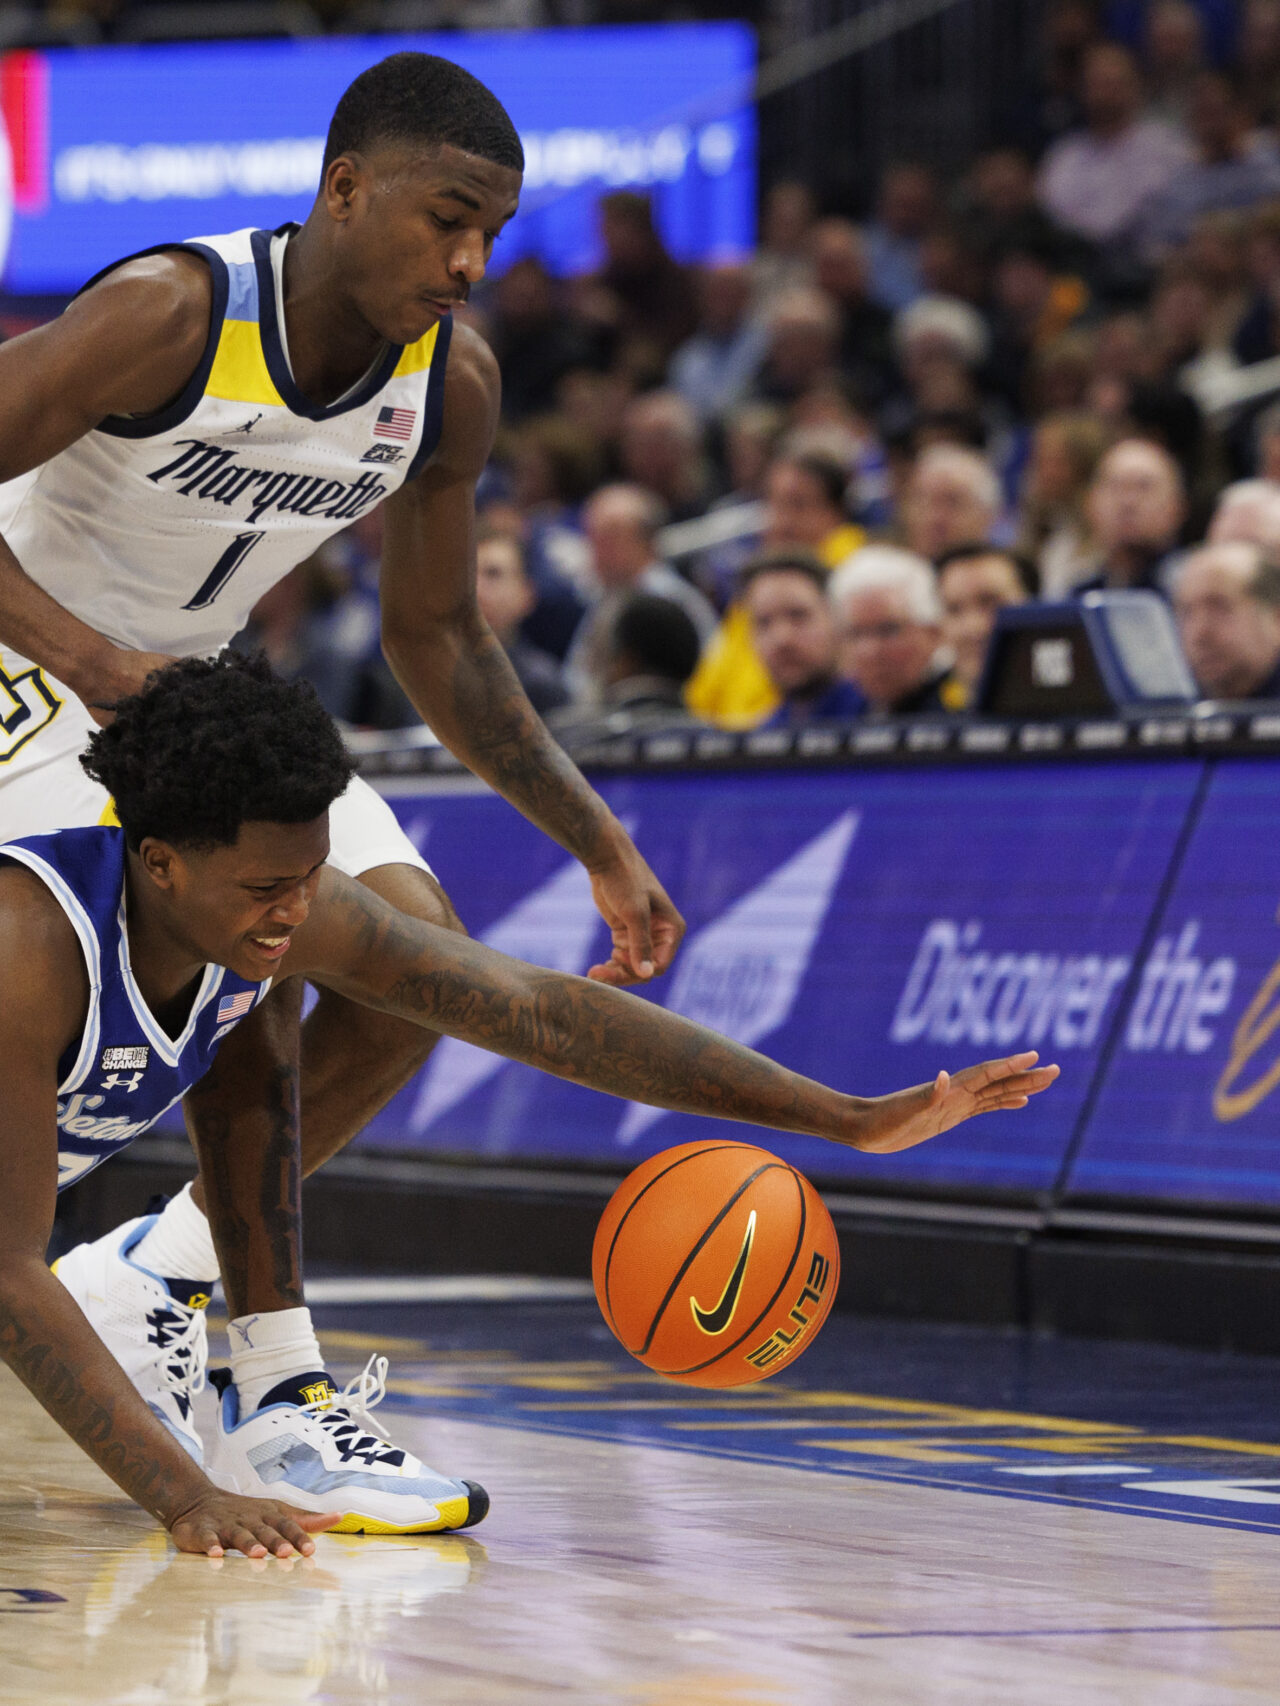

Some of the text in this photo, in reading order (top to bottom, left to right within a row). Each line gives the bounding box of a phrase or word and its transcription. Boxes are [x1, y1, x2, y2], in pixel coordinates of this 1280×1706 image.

[362, 449, 407, 463] EAST
[371, 443, 404, 454] BIG
[147, 439, 387, 524] Marquette
[181, 530, 267, 611] 1
[890, 919, 1130, 1046] Discover
[1124, 919, 1237, 1053] the
[101, 1059, 148, 1070] CHANGE
[111, 1047, 135, 1060] BE
[743, 1250, 830, 1369] ELITE
